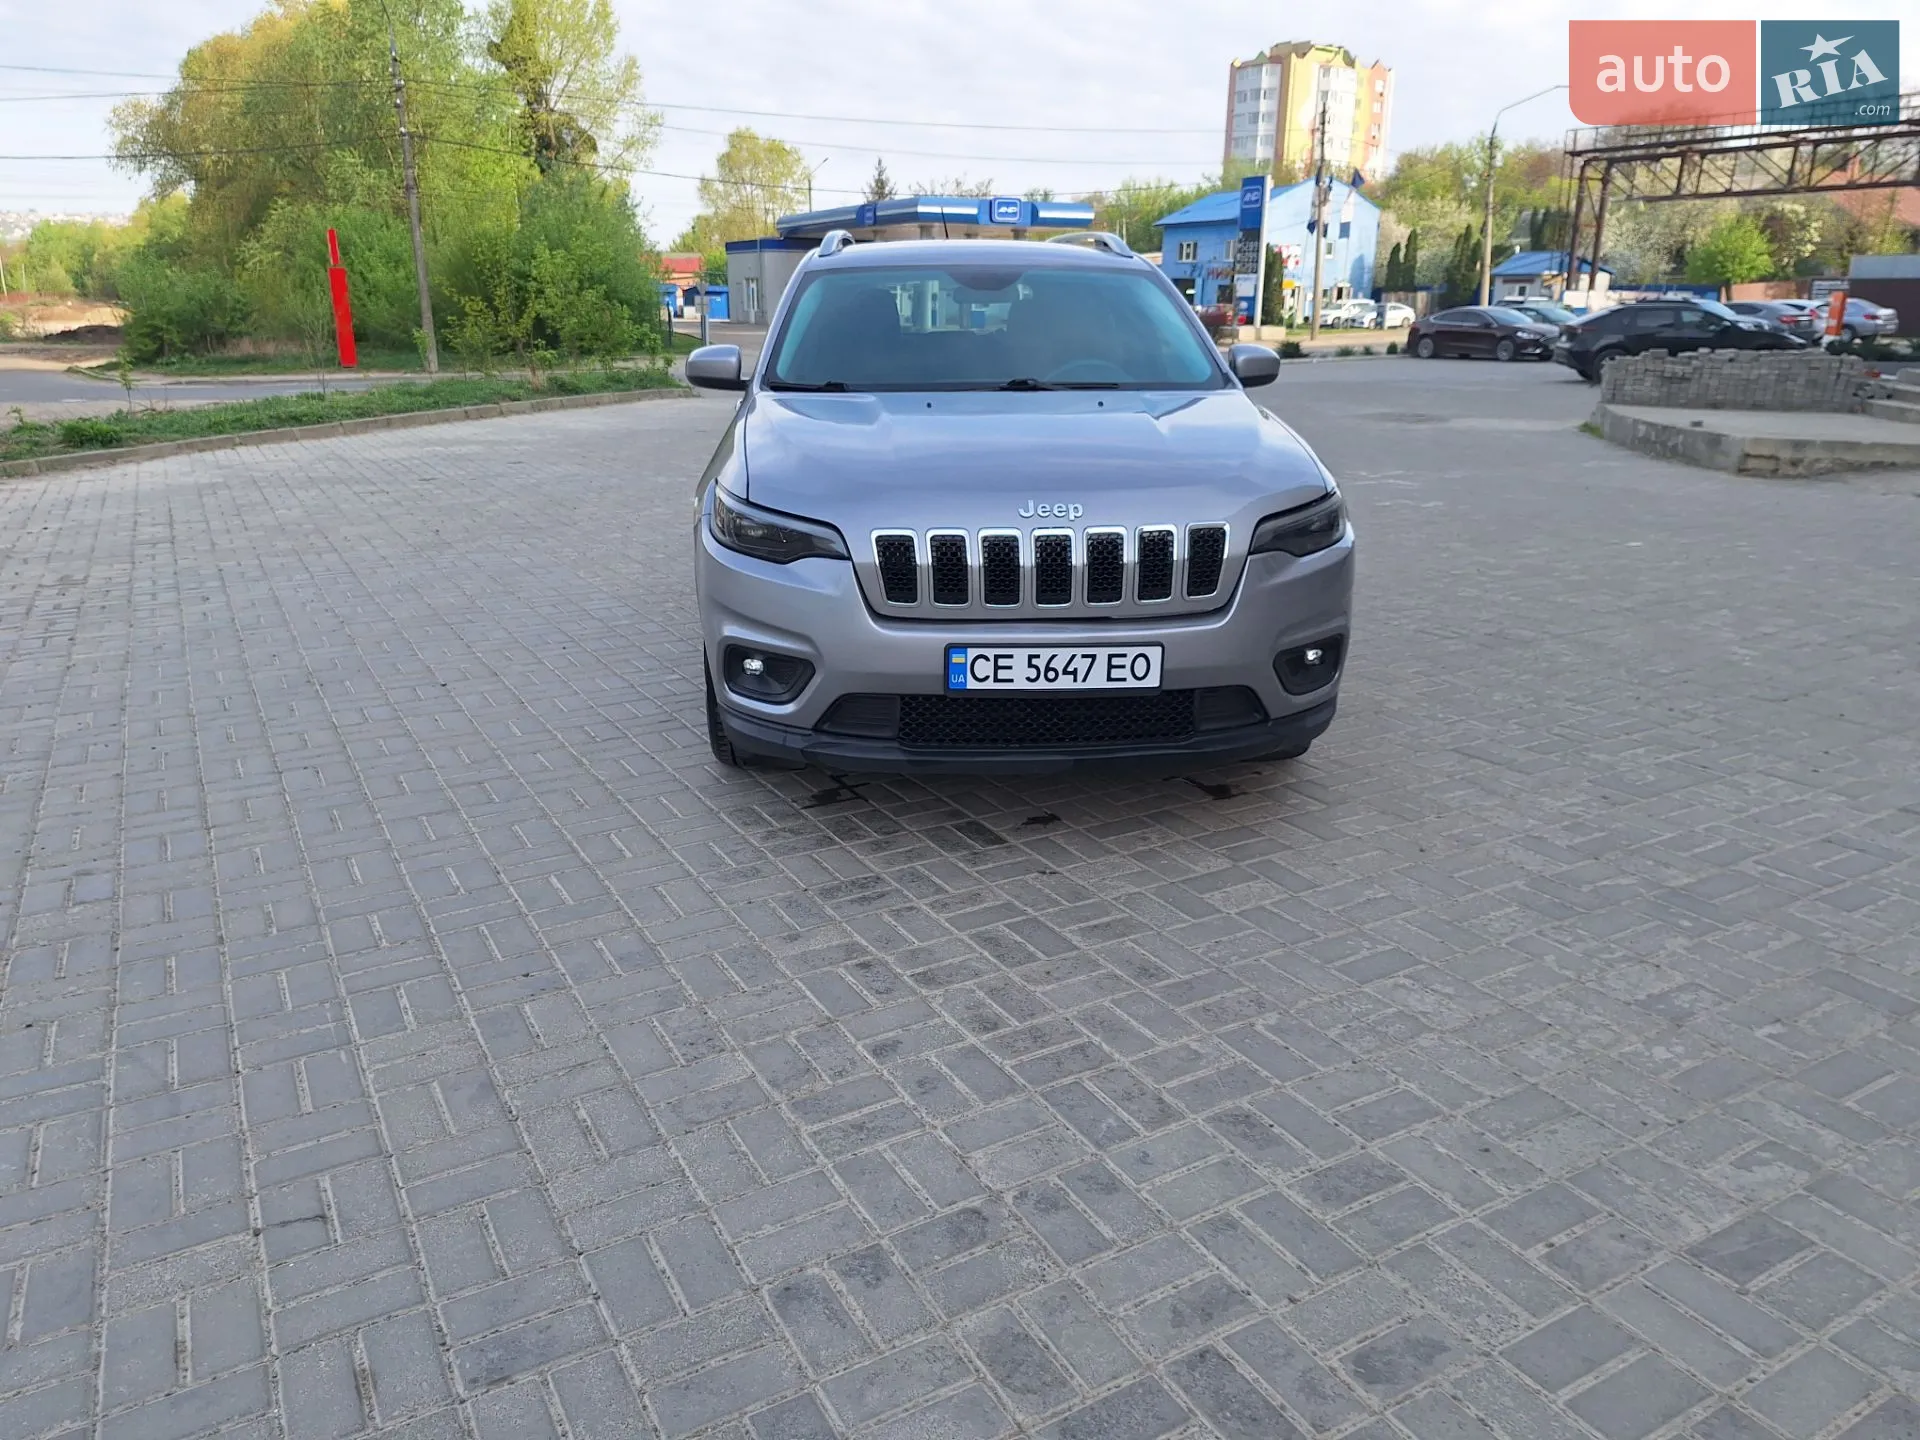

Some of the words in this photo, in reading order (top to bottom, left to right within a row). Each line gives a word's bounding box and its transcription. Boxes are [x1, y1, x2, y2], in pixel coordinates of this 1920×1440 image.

[1018, 500, 1084, 521] Jeep
[951, 673, 966, 684] UA
[969, 653, 1015, 684] CE
[1025, 653, 1098, 684] 5647
[1106, 652, 1152, 683] EO
